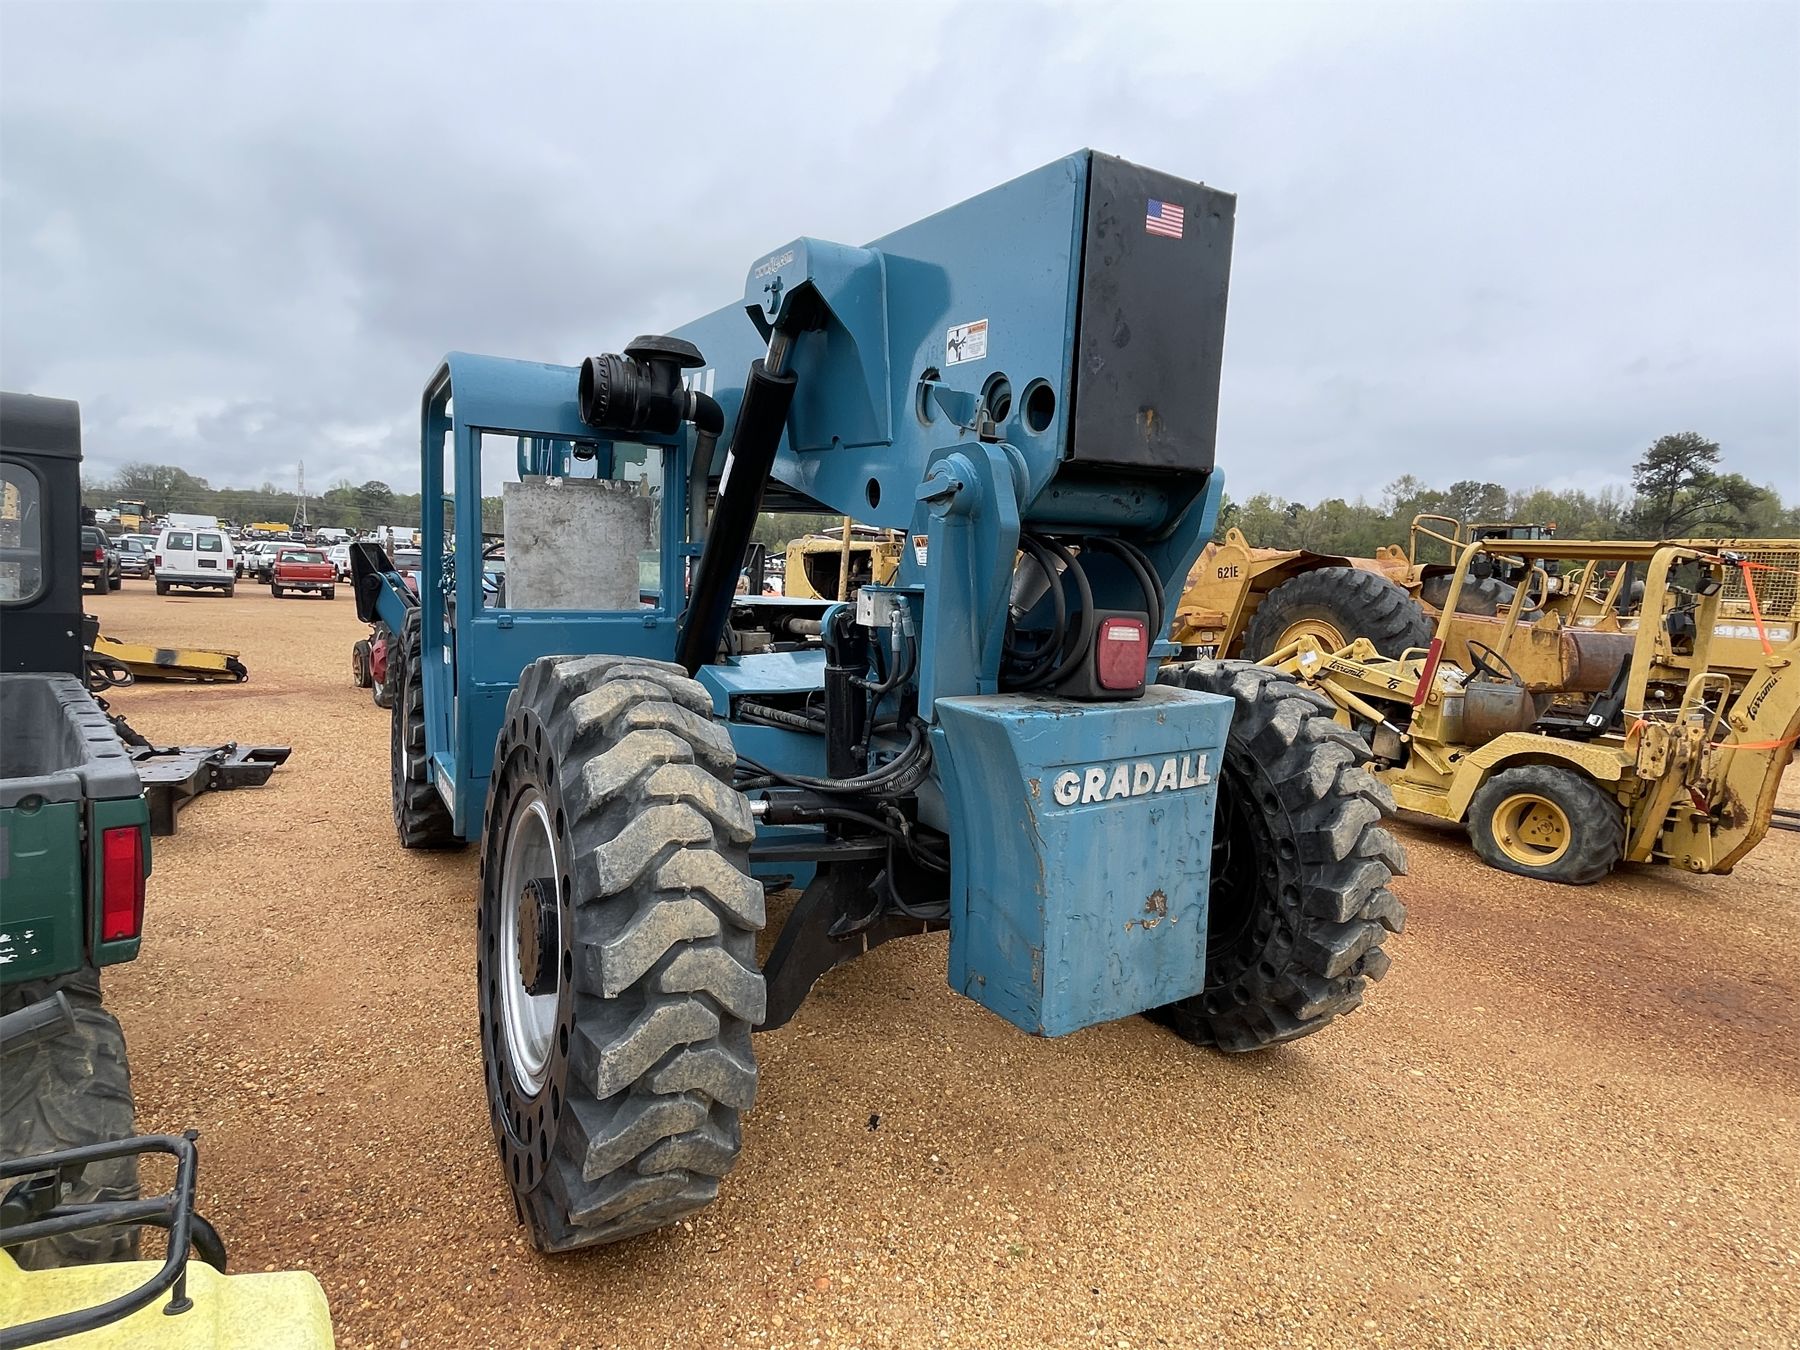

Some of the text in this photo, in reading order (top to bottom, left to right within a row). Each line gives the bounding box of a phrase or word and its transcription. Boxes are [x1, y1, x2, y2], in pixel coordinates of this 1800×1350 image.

[1217, 566, 1239, 579] 621E
[1387, 676, 1402, 690] T6
[1053, 753, 1212, 807] GRADALL
